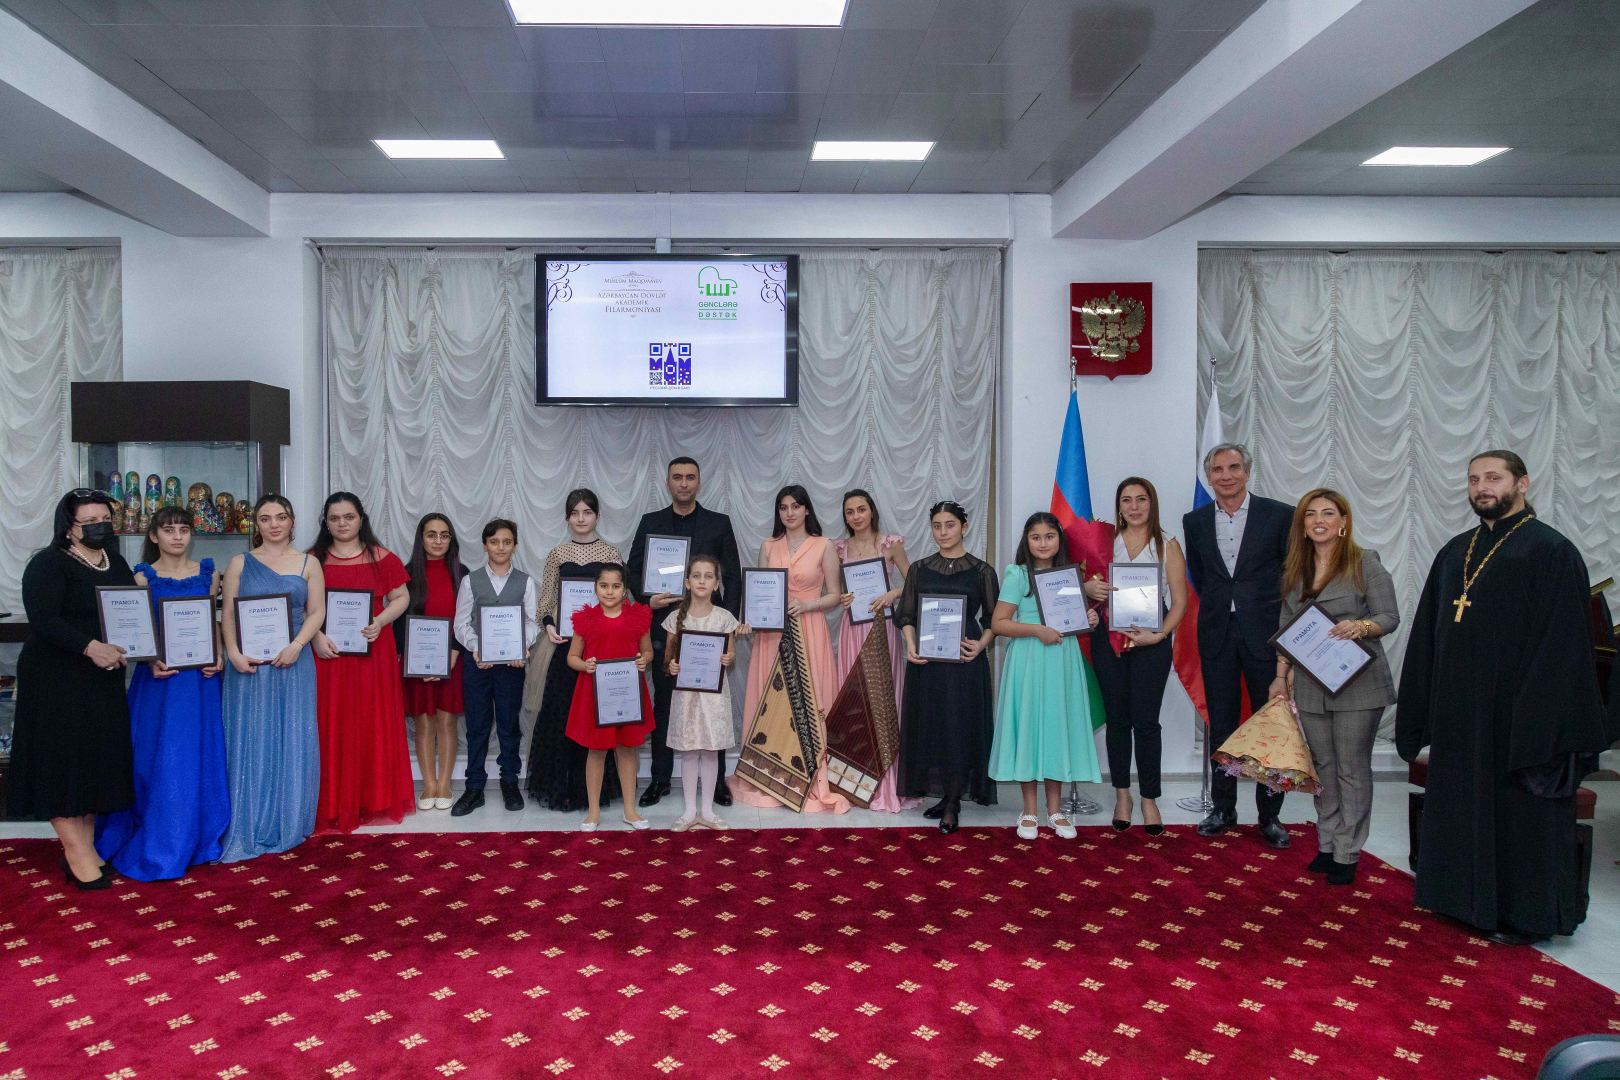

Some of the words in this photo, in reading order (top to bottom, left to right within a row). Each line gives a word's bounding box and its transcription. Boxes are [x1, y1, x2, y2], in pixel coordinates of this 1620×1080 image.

[852, 570, 876, 578] ГРАМОТА
[1046, 578, 1070, 588] ГРАМОТА
[1292, 620, 1316, 644] ГРАМОТА
